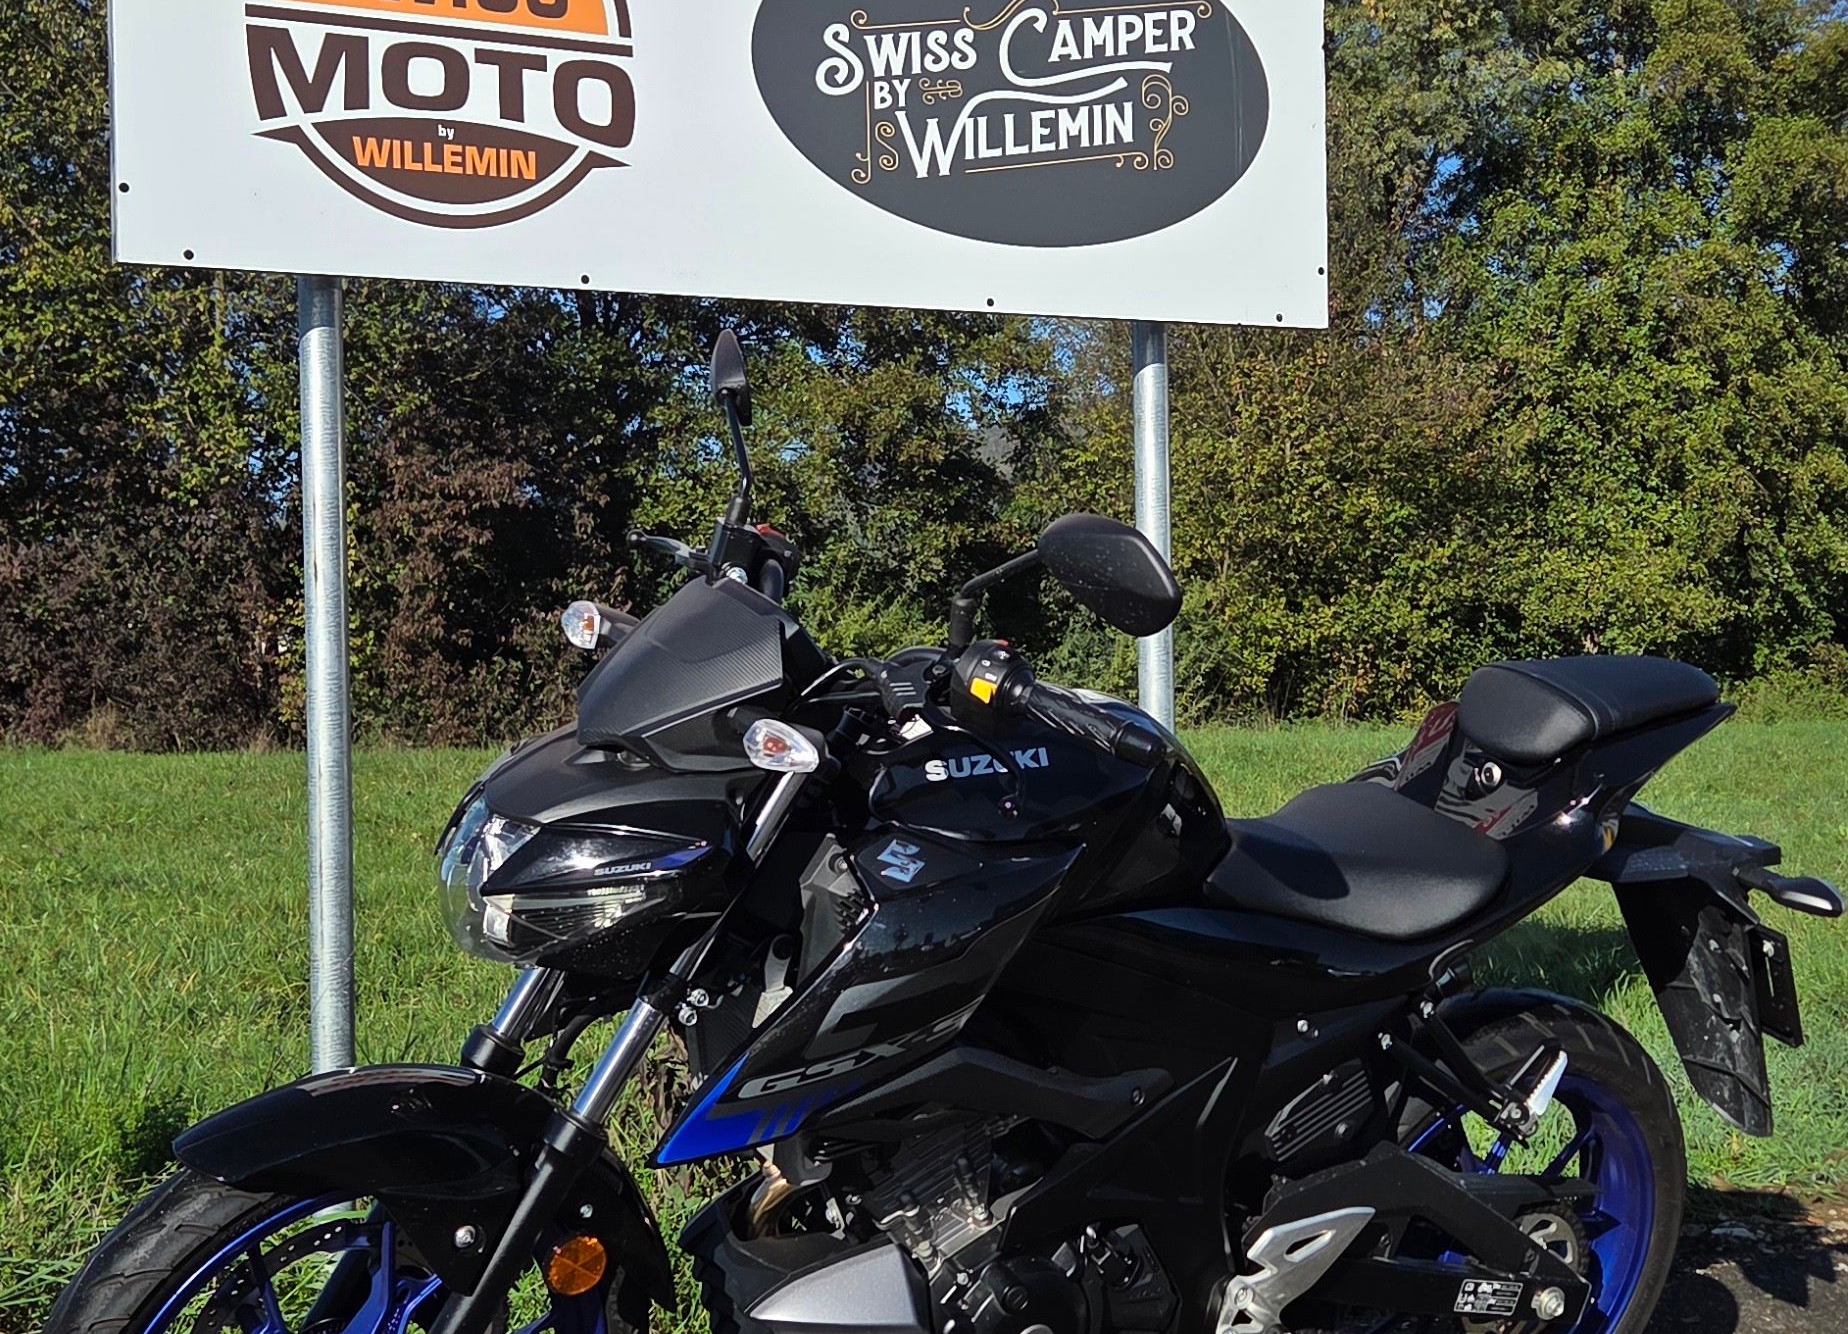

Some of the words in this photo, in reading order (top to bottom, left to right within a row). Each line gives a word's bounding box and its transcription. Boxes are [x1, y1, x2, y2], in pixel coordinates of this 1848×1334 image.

[815, 22, 977, 96] SWISS
[998, 7, 1196, 87] CAMPER
[245, 23, 636, 149] MOTO
[873, 78, 912, 110] BY
[437, 124, 455, 141] by
[895, 76, 1134, 179] WILLEMIN
[352, 135, 537, 180] WILLEMIN
[593, 862, 652, 876] SUZUKI
